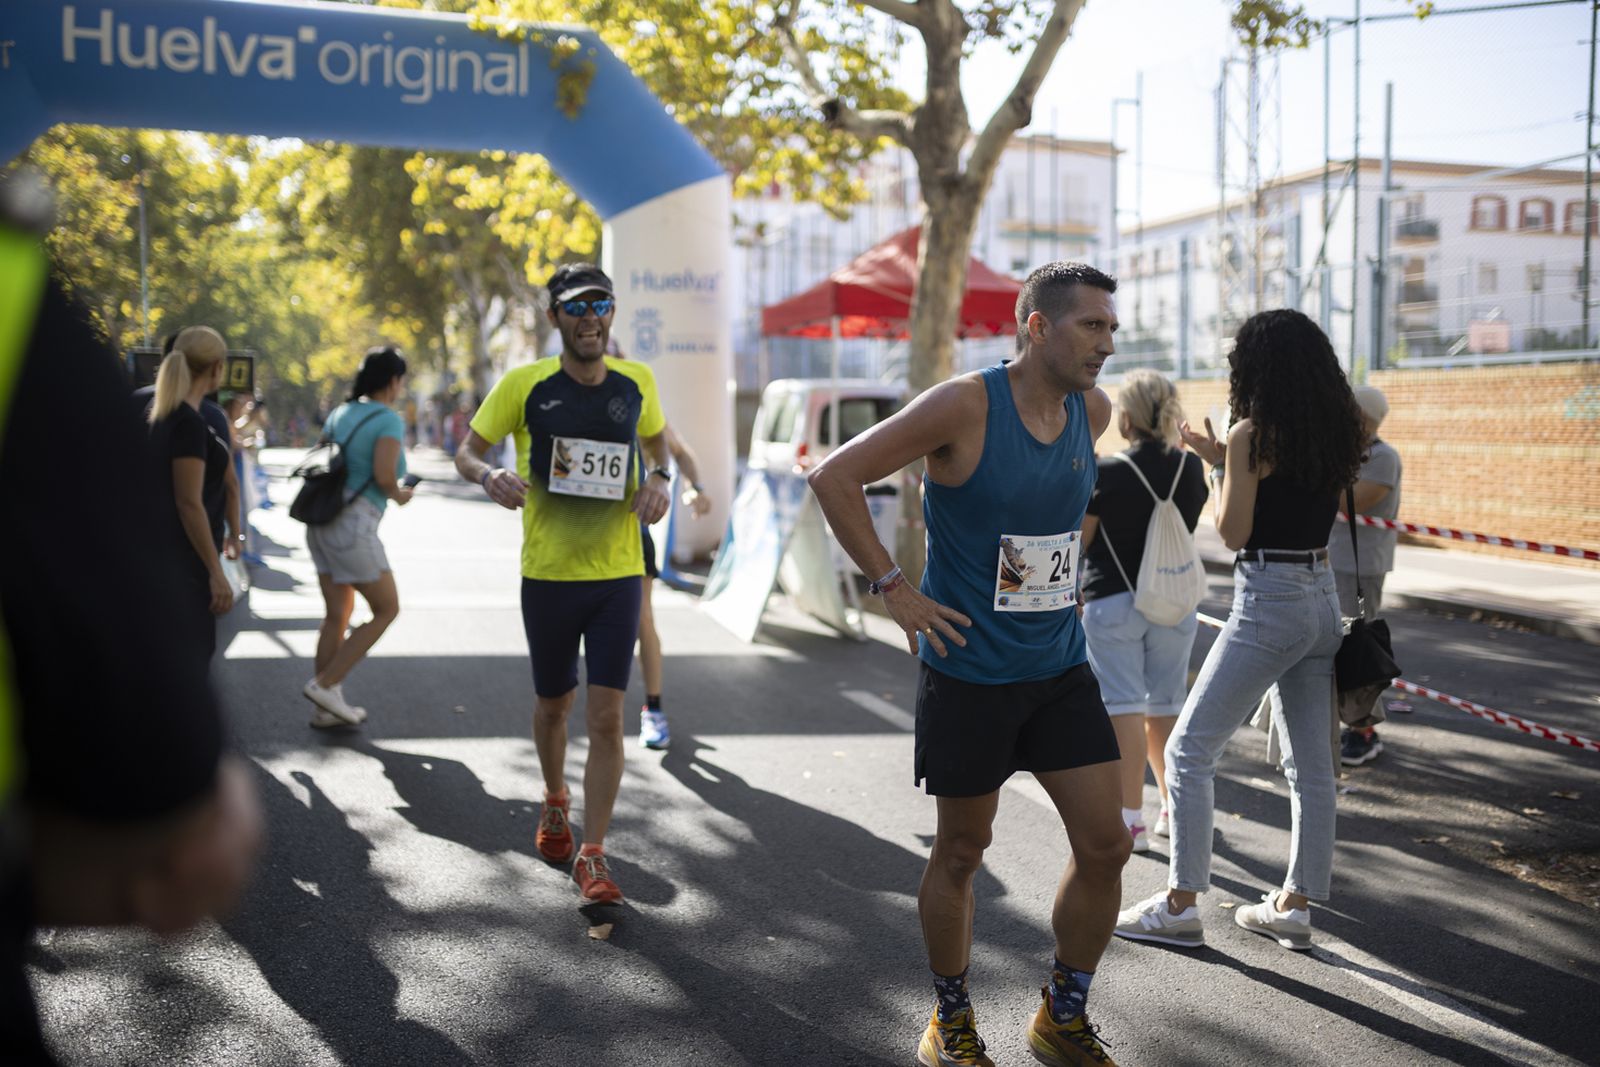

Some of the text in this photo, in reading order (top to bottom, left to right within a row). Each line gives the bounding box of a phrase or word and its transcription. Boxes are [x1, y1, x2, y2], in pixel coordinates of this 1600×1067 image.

[62, 5, 530, 104] Huelva original
[629, 268, 721, 294] Huelva
[581, 452, 622, 479] 516
[1049, 548, 1071, 583] 24
